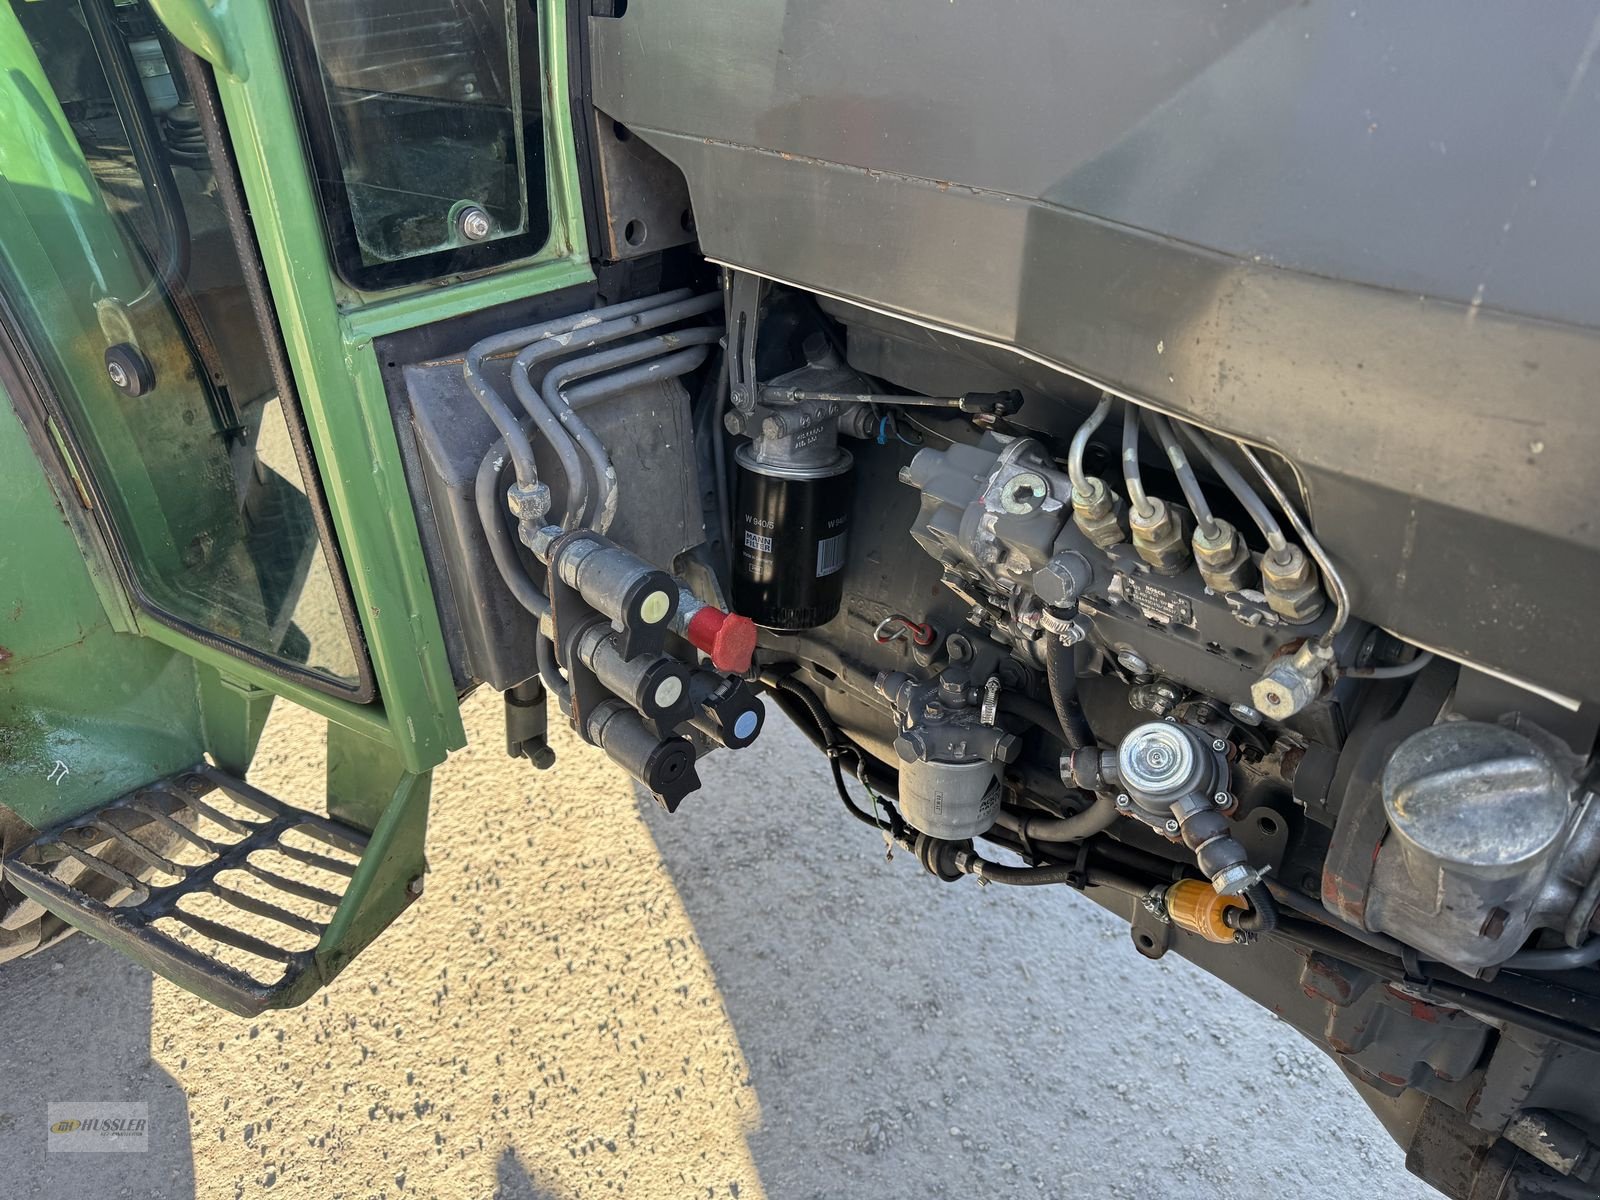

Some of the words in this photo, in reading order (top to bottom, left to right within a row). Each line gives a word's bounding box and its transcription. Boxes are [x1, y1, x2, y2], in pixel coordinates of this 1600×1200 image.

[745, 513, 753, 523] W
[753, 517, 775, 530] 940/5
[746, 532, 771, 545] MANN
[746, 538, 771, 552] FILTER
